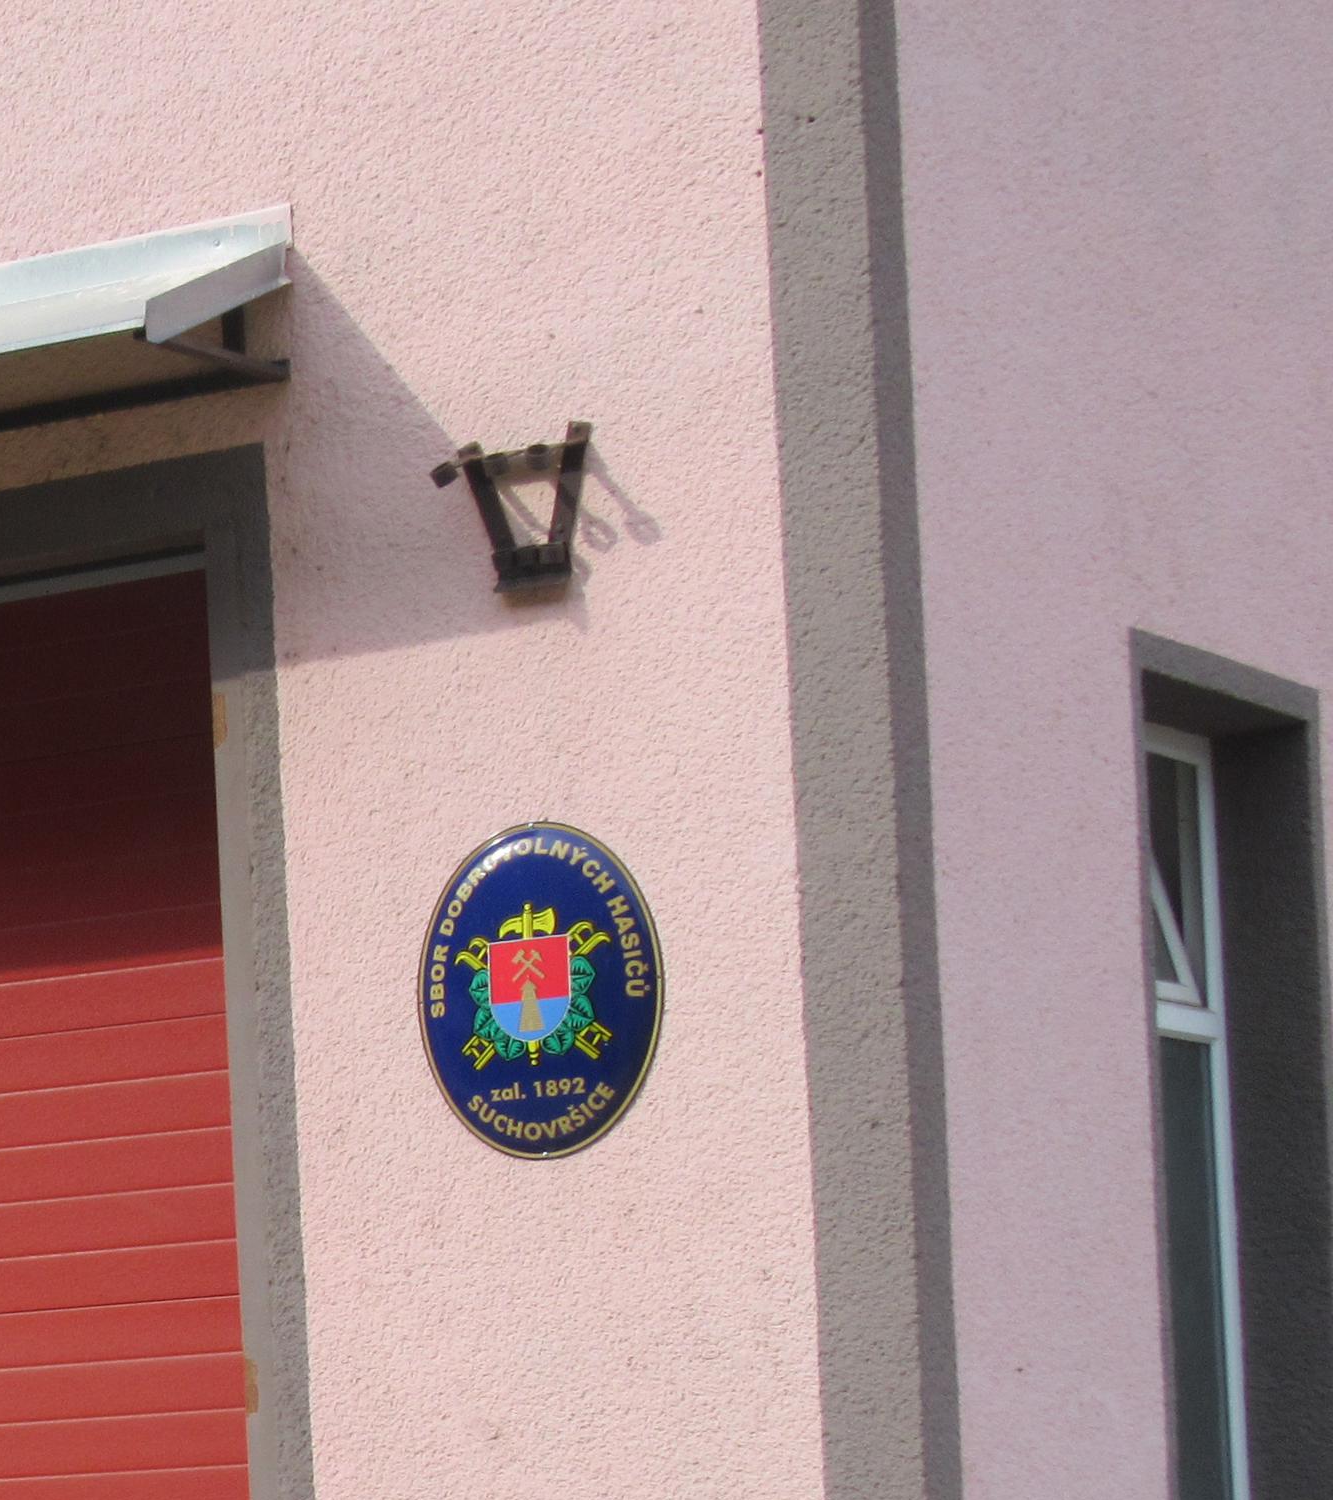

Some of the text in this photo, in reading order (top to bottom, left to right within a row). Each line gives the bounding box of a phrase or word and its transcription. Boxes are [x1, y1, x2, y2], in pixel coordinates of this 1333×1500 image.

[430, 837, 651, 1018] SBOR DOBROVOLNÝCH HASIČŮ
[467, 1081, 616, 1142] SUCHOVRŠICE
[491, 1077, 586, 1102] zal. 1892
